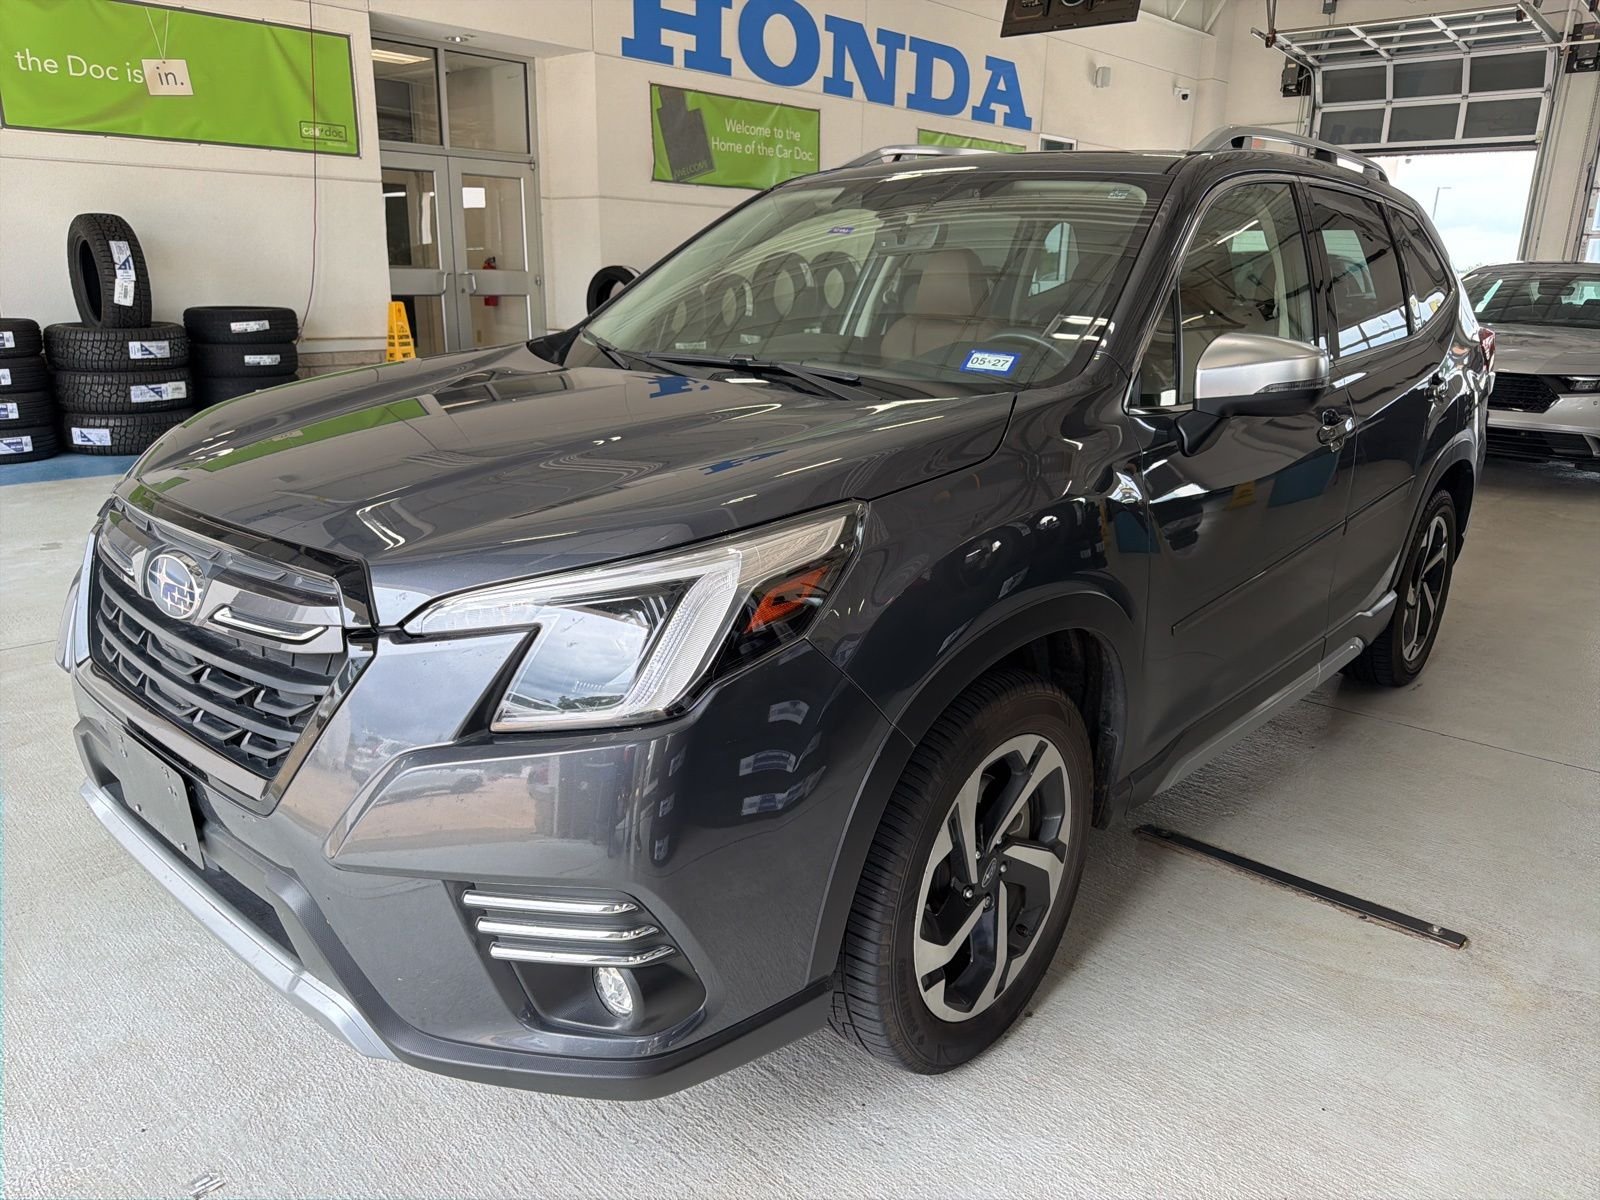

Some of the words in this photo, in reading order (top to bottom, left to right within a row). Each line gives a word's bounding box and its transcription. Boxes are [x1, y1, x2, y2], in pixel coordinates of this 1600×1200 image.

[14, 48, 59, 75] the
[67, 55, 120, 82] Doc
[127, 61, 145, 84] is
[155, 65, 186, 87] in.
[621, 0, 1033, 131] HONDA
[725, 118, 771, 137] Welcome
[774, 127, 784, 138] to
[786, 127, 801, 141] the
[711, 136, 742, 153] Home
[745, 142, 756, 154] of
[757, 143, 775, 157] the
[775, 144, 793, 159] Car
[794, 147, 815, 161] Doc.
[970, 357, 987, 365] 05
[991, 358, 1009, 367] 27
